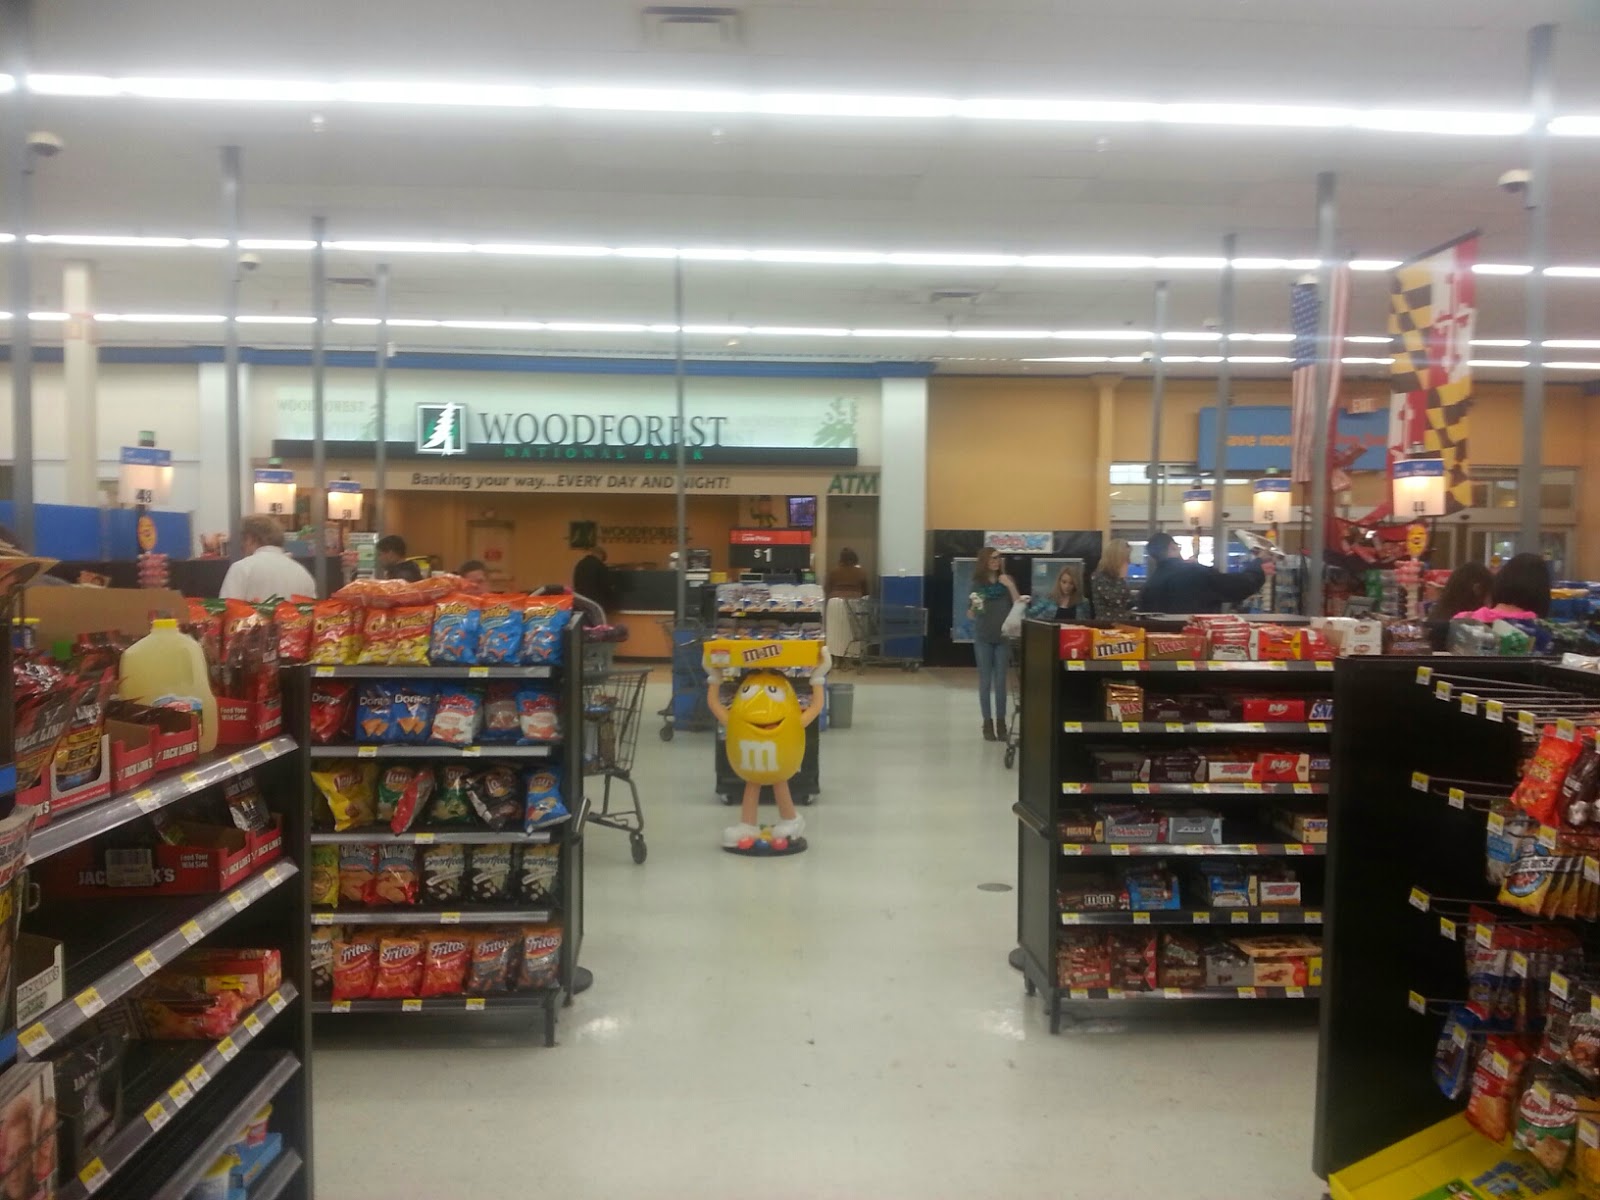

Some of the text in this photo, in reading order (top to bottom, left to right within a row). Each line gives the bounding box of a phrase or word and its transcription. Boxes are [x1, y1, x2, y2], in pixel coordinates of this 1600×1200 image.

[478, 412, 727, 447] WOODFOREST
[504, 448, 704, 460] NATIONAL BAK
[411, 472, 477, 487] Banking
[475, 474, 510, 488] your
[606, 475, 639, 488] DAY
[640, 476, 674, 489] AND
[828, 474, 879, 494] ATM
[753, 547, 773, 563] $1
[163, 747, 178, 760] JACK
[431, 940, 465, 956] Fritos
[526, 935, 560, 950] Fritos
[341, 944, 372, 962] Fritos
[382, 945, 418, 962] Fritos
